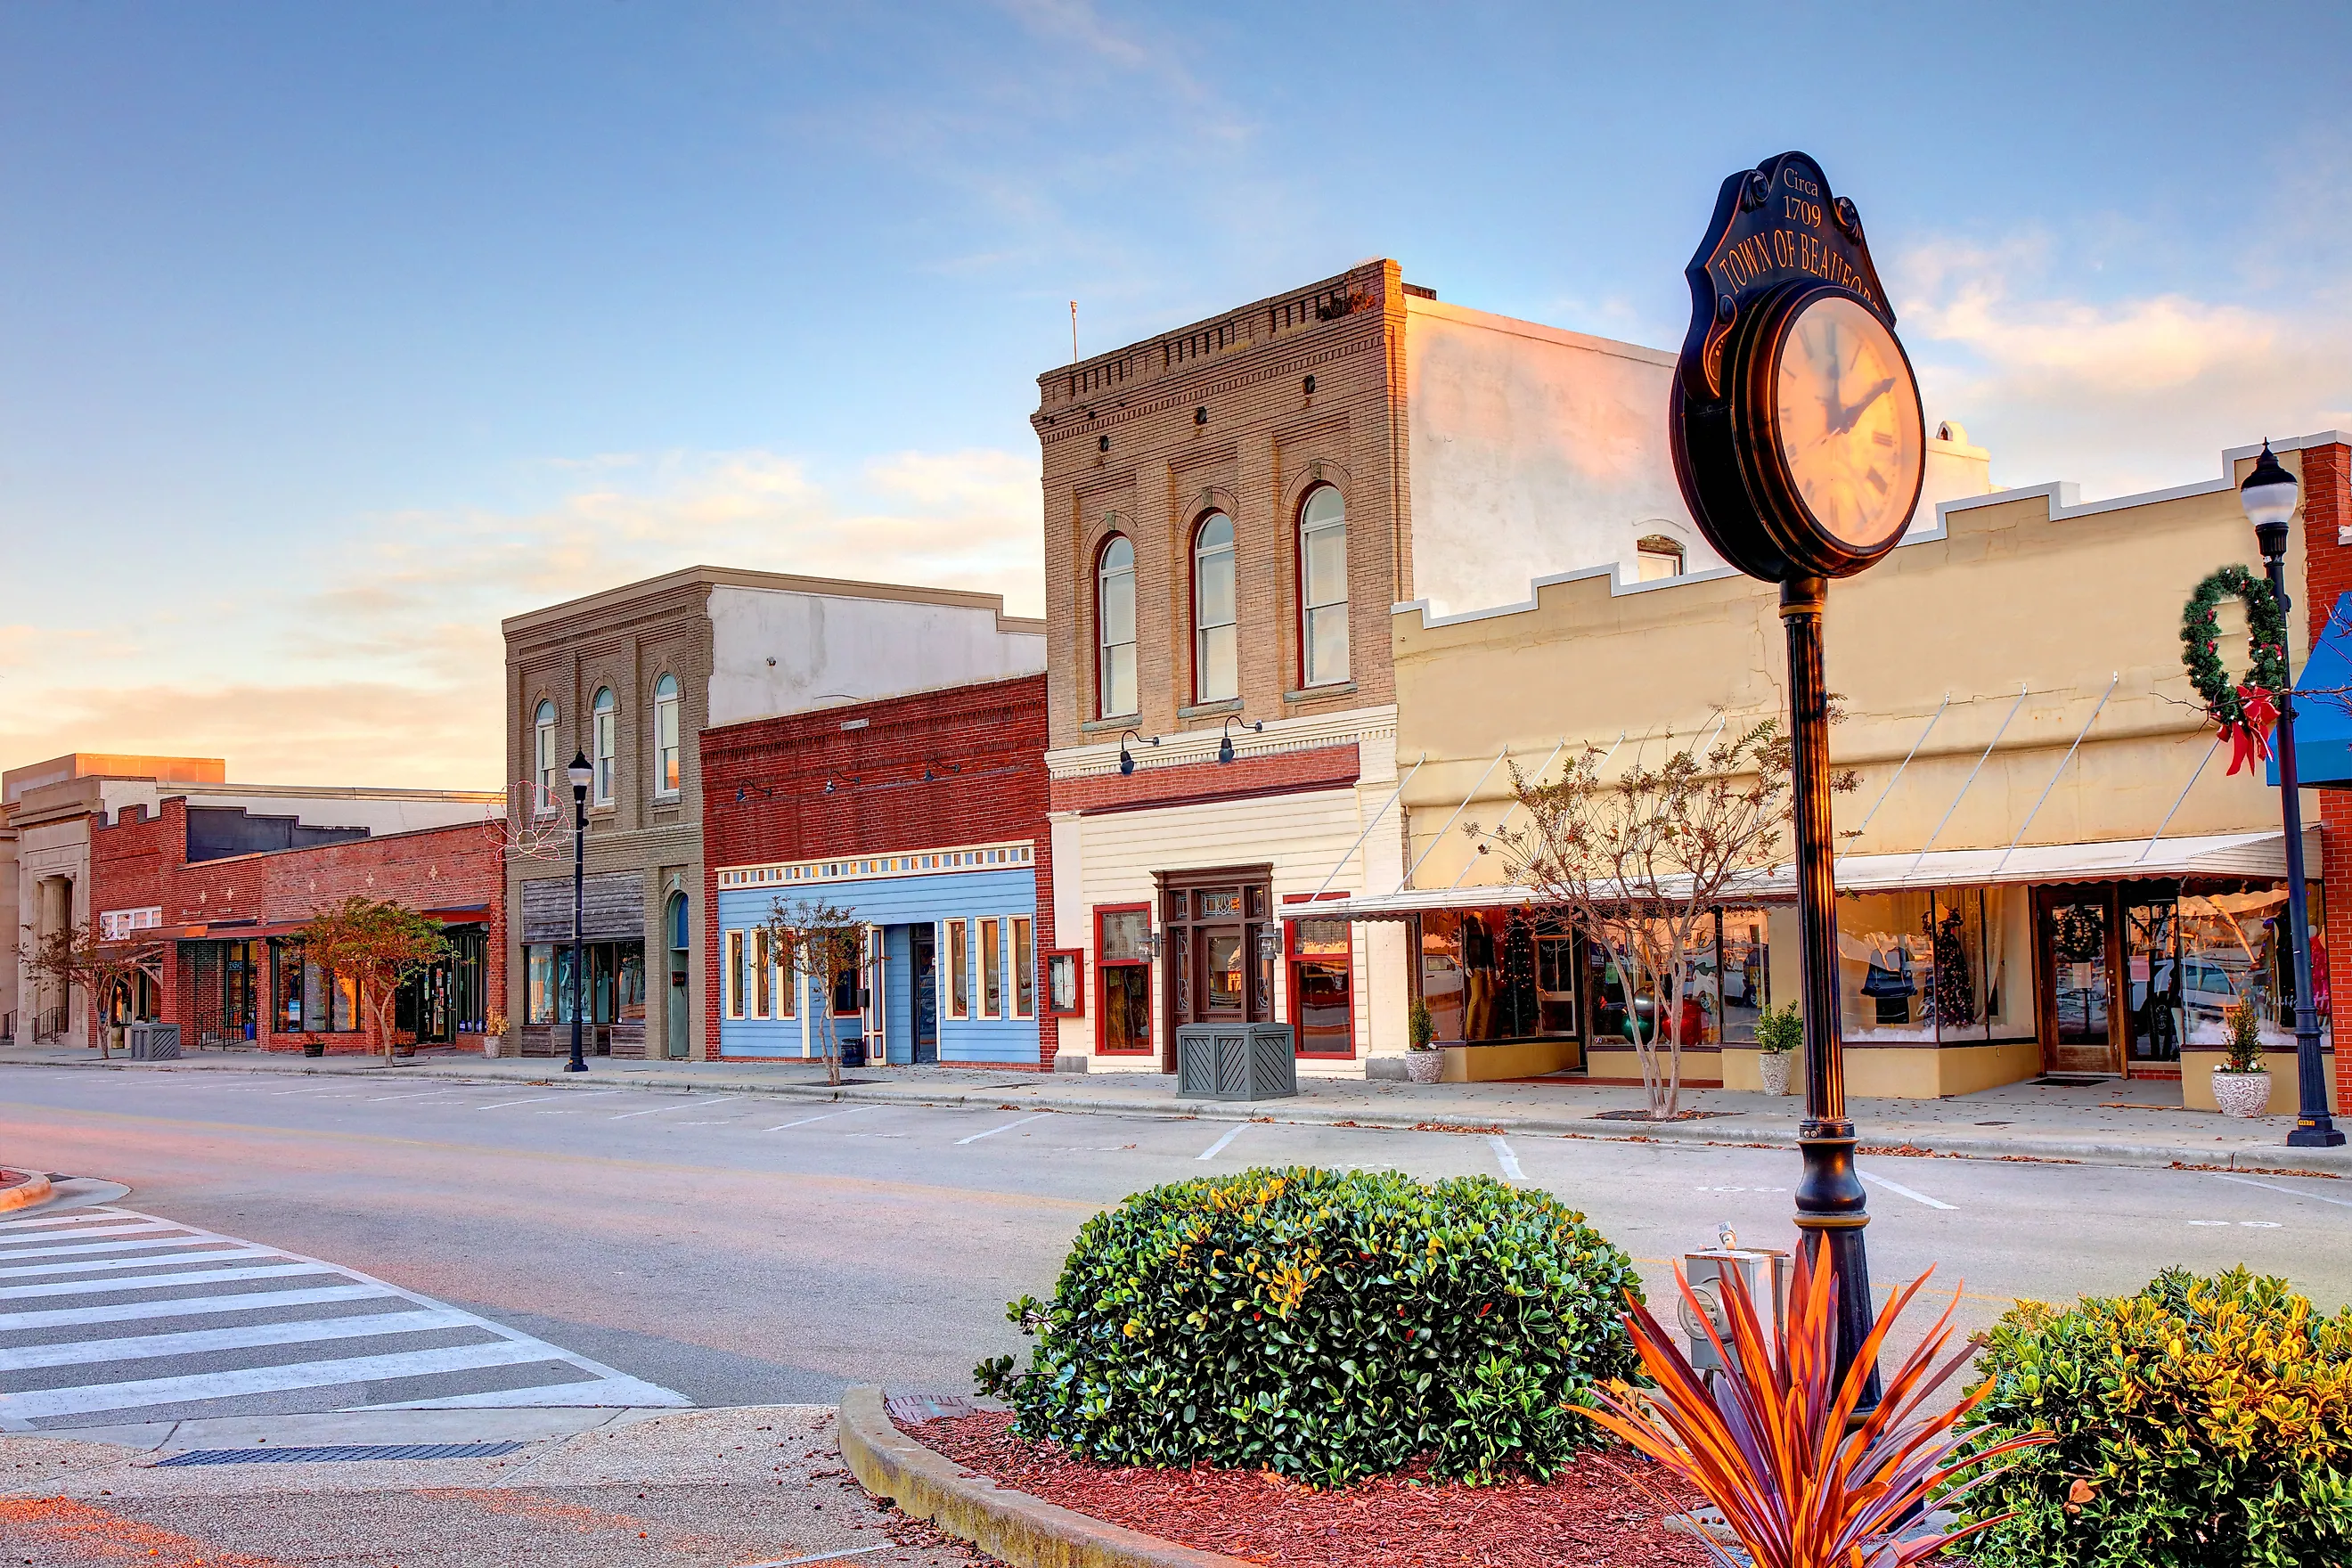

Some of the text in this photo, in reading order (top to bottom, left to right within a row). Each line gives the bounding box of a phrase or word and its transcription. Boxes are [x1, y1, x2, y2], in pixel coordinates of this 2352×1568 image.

[1783, 167, 1818, 198] Circa
[1783, 195, 1822, 228] 1709
[1719, 229, 1881, 312] TOWN OF BEAUFO
